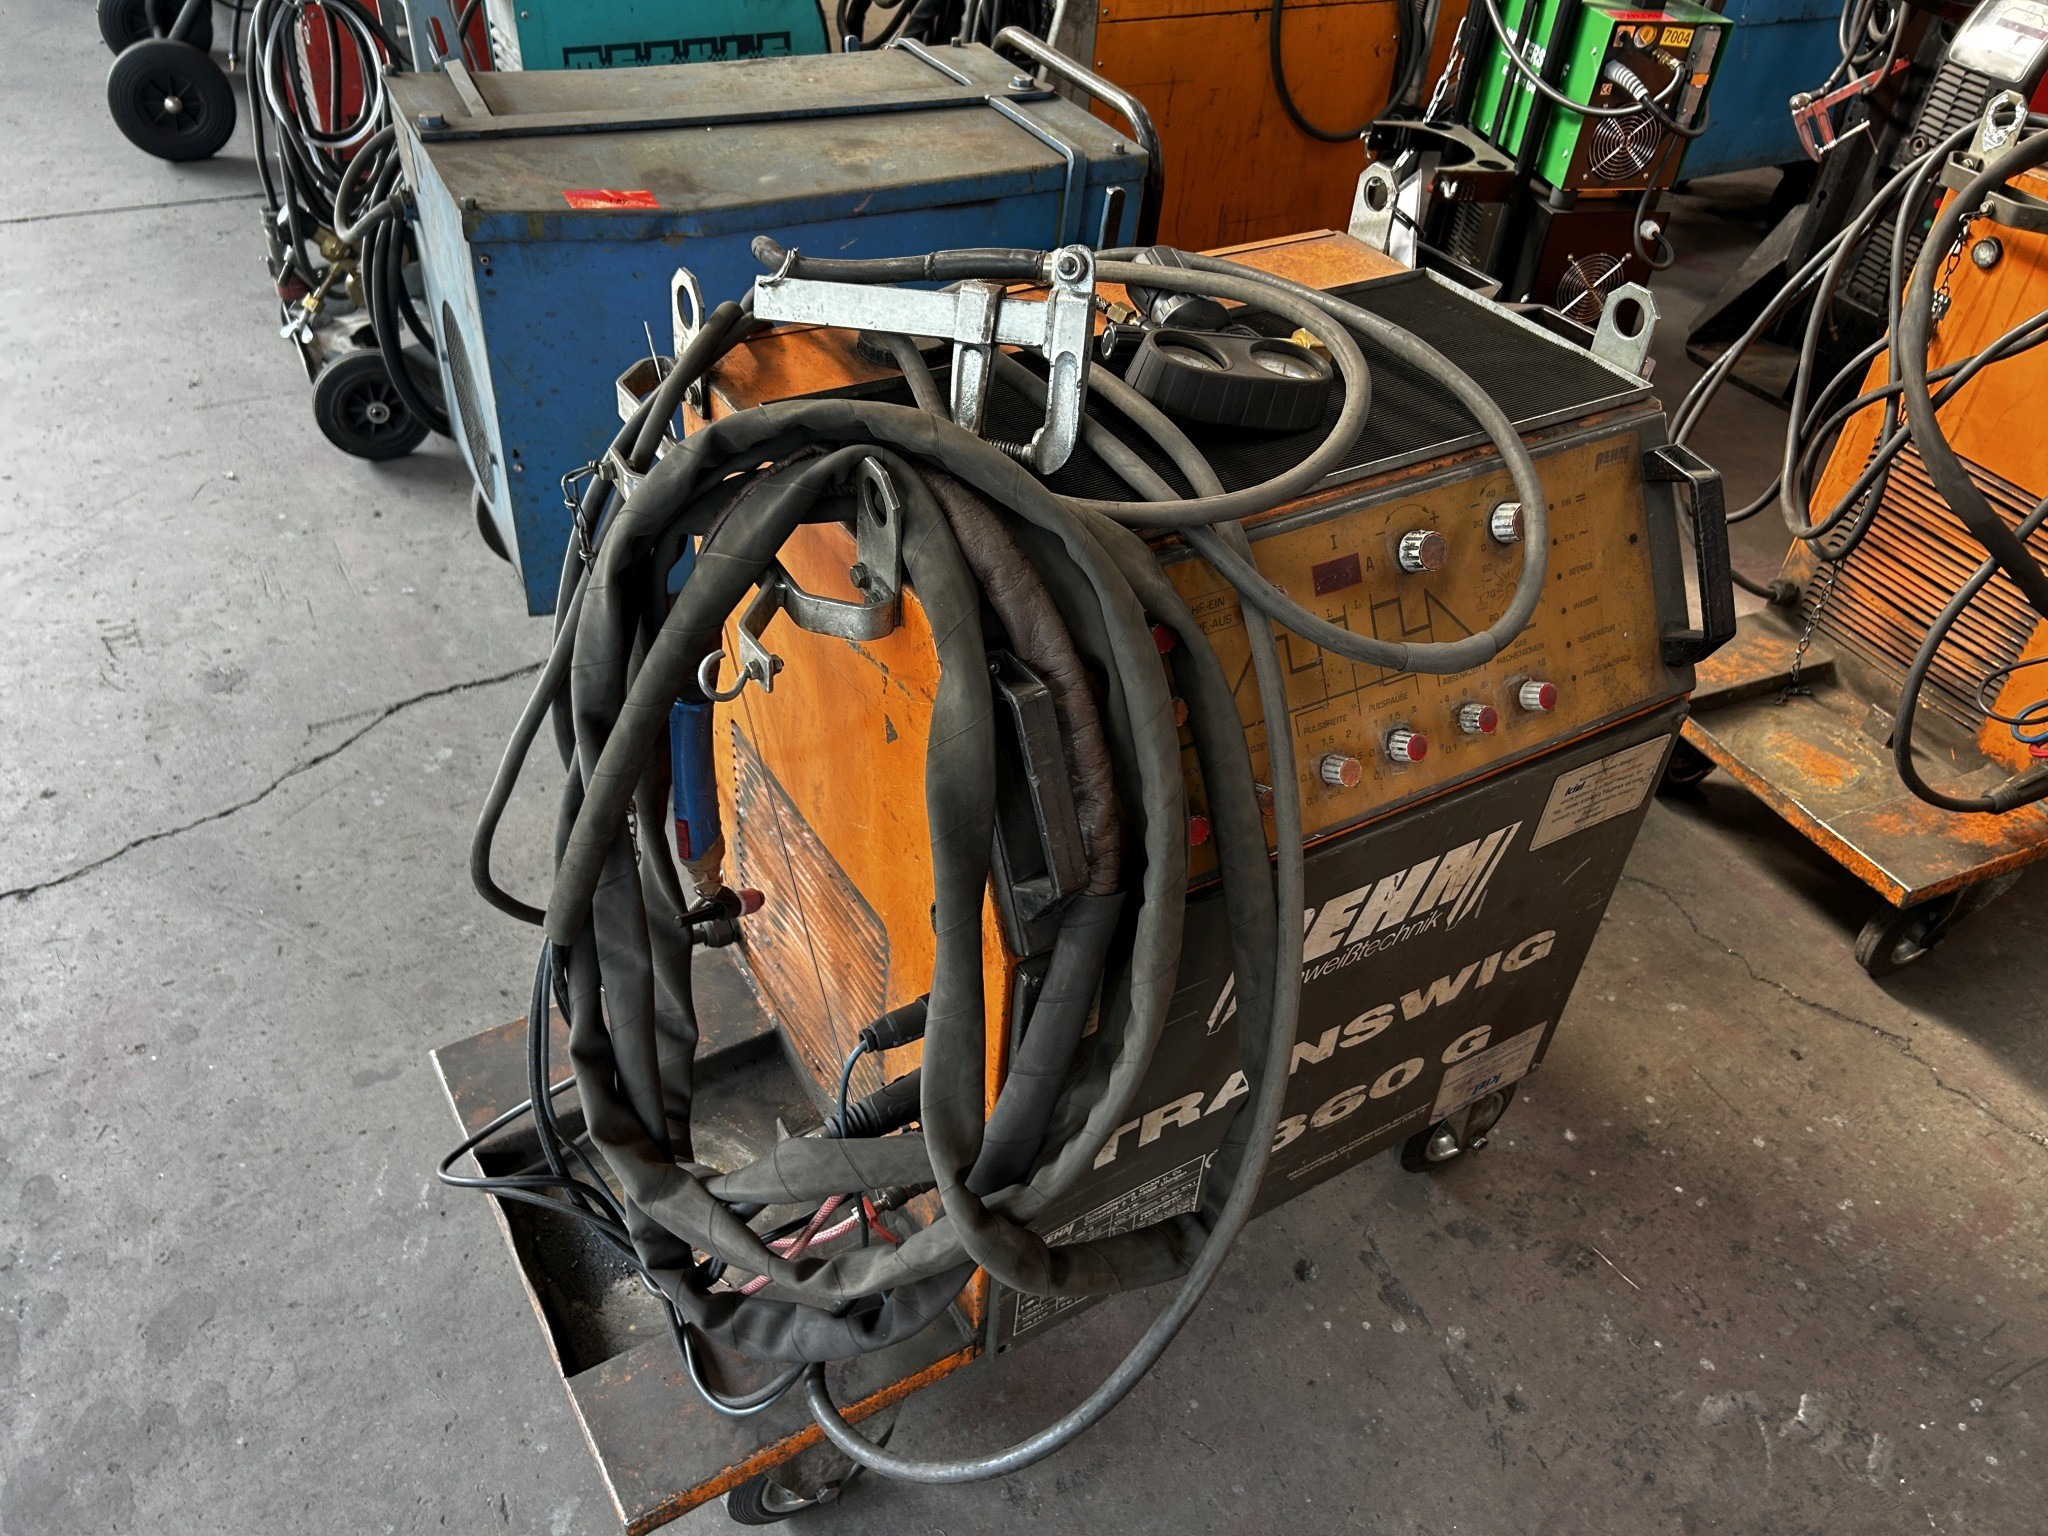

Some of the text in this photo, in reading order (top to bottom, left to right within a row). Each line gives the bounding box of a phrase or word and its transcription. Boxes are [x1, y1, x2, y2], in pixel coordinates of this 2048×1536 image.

[1664, 29, 1690, 45] 7004
[1473, 519, 1483, 529] 20
[1366, 556, 1374, 572] A
[1485, 589, 1496, 599] 70
[1572, 595, 1598, 610] WASSER
[1489, 612, 1499, 623] 80
[1577, 623, 1616, 645] TEMPERATUR
[1514, 638, 1527, 649] GAS
[1583, 653, 1632, 678] PHASENAUSFALL
[1368, 691, 1409, 713] PULSPAUSE
[1303, 714, 1349, 736] PULSBREITE
[1388, 711, 1401, 723] 1,5
[1321, 735, 1335, 747] 1,5
[1345, 730, 1352, 739] 2
[1301, 771, 1314, 783] 0,5
[1564, 781, 1586, 797] kiel
[1301, 909, 1445, 985] weißtechnik
[1271, 1057, 1425, 1154] 360
[1441, 1024, 1492, 1064] G
